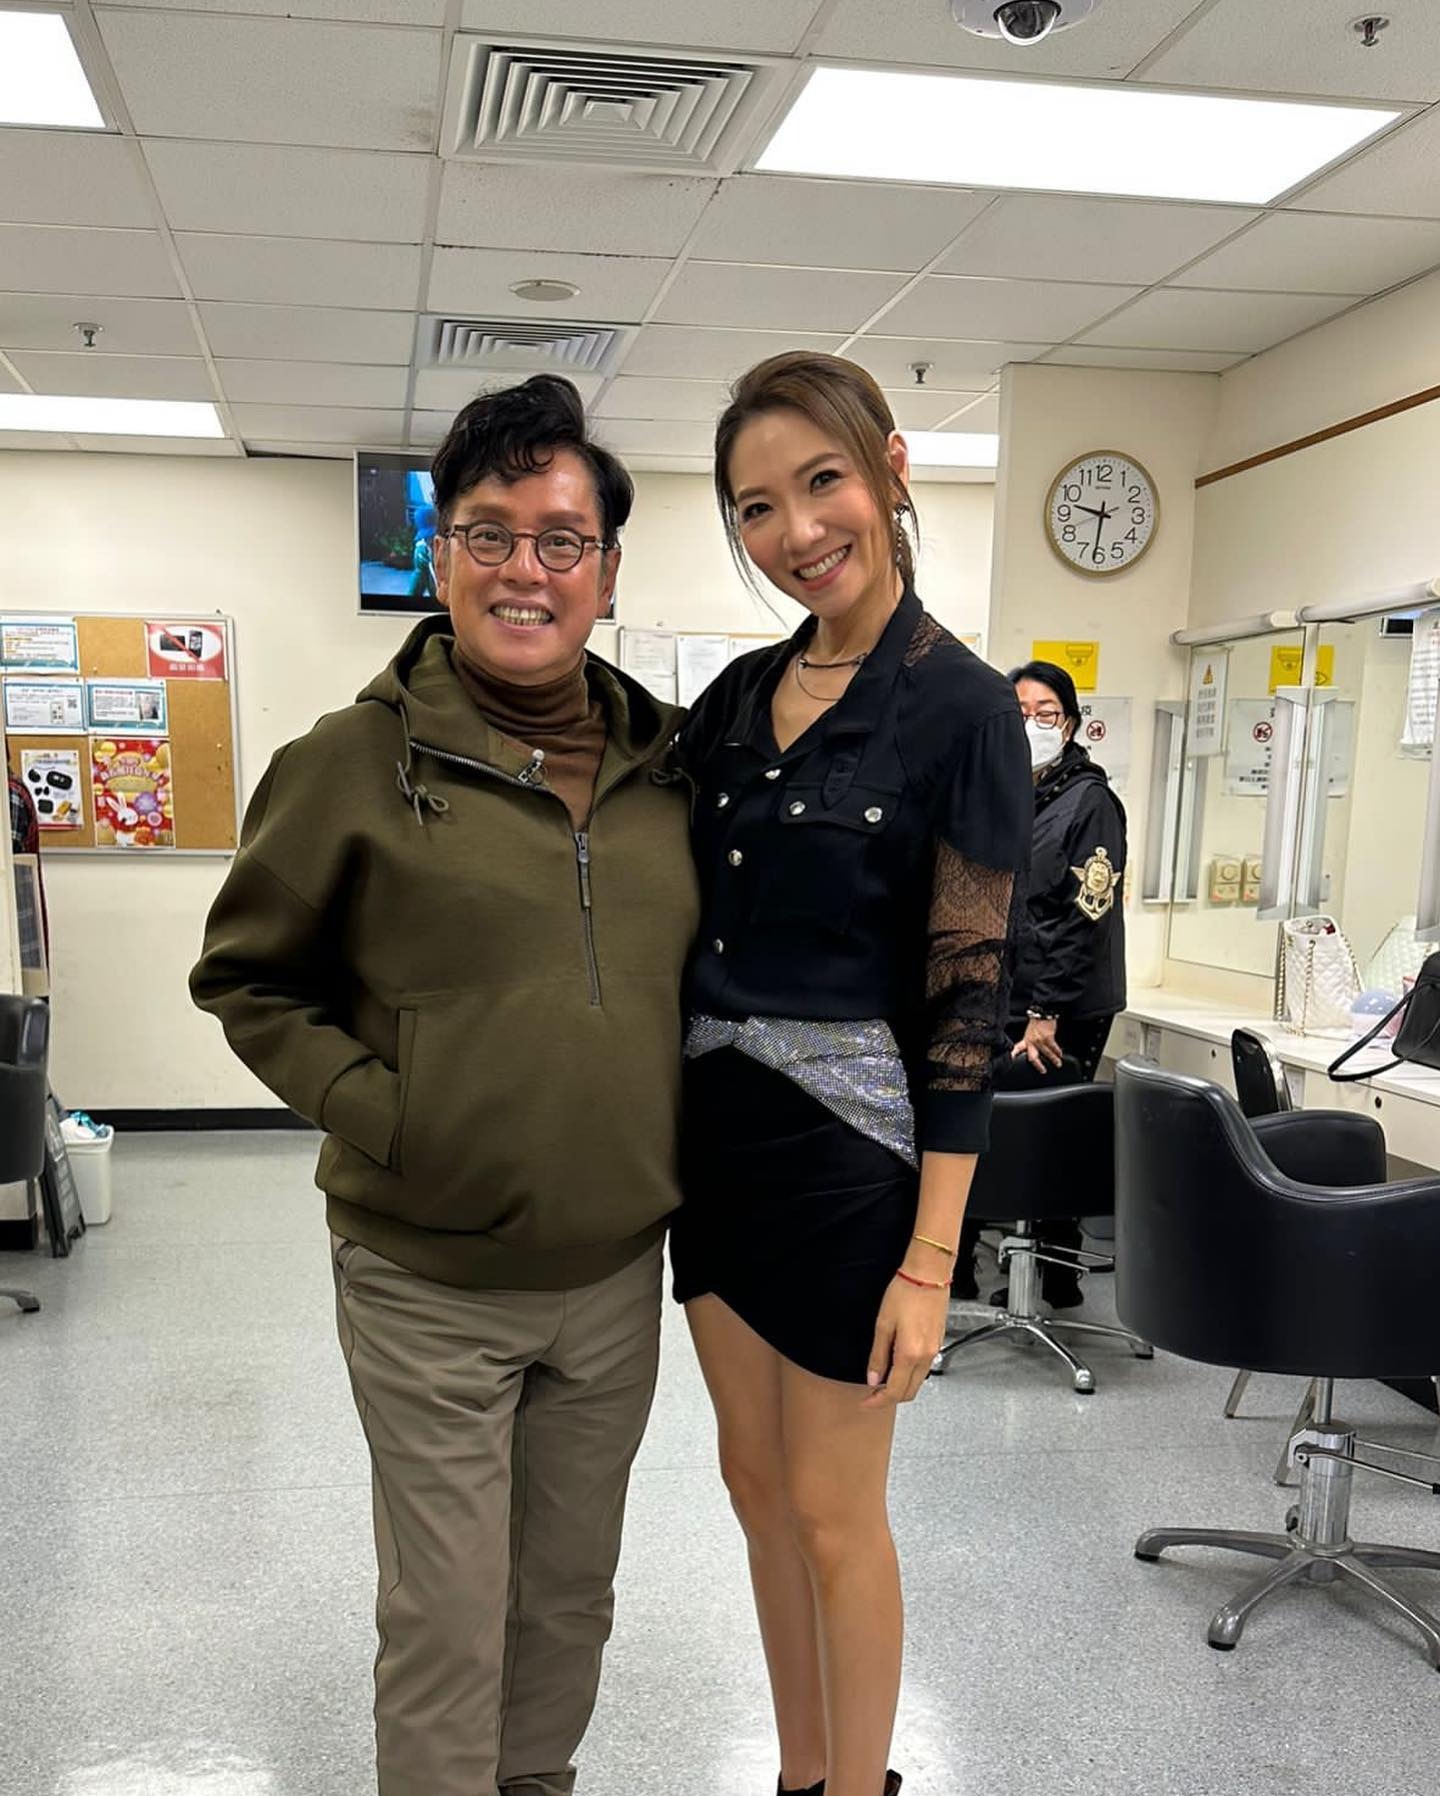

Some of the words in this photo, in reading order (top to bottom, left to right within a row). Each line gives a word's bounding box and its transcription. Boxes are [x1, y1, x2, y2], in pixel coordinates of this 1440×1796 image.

[1079, 469, 1092, 486] 11
[1096, 464, 1113, 482] 12
[1120, 470, 1126, 487] 1
[1063, 484, 1082, 502] 10
[1127, 485, 1141, 503] 2
[1057, 504, 1071, 522] 9
[1131, 507, 1145, 524] 3
[1062, 524, 1076, 542] 8
[1124, 527, 1137, 543] 4
[1077, 542, 1090, 558] 7
[1092, 546, 1106, 564] 6
[1110, 542, 1124, 559] 5
